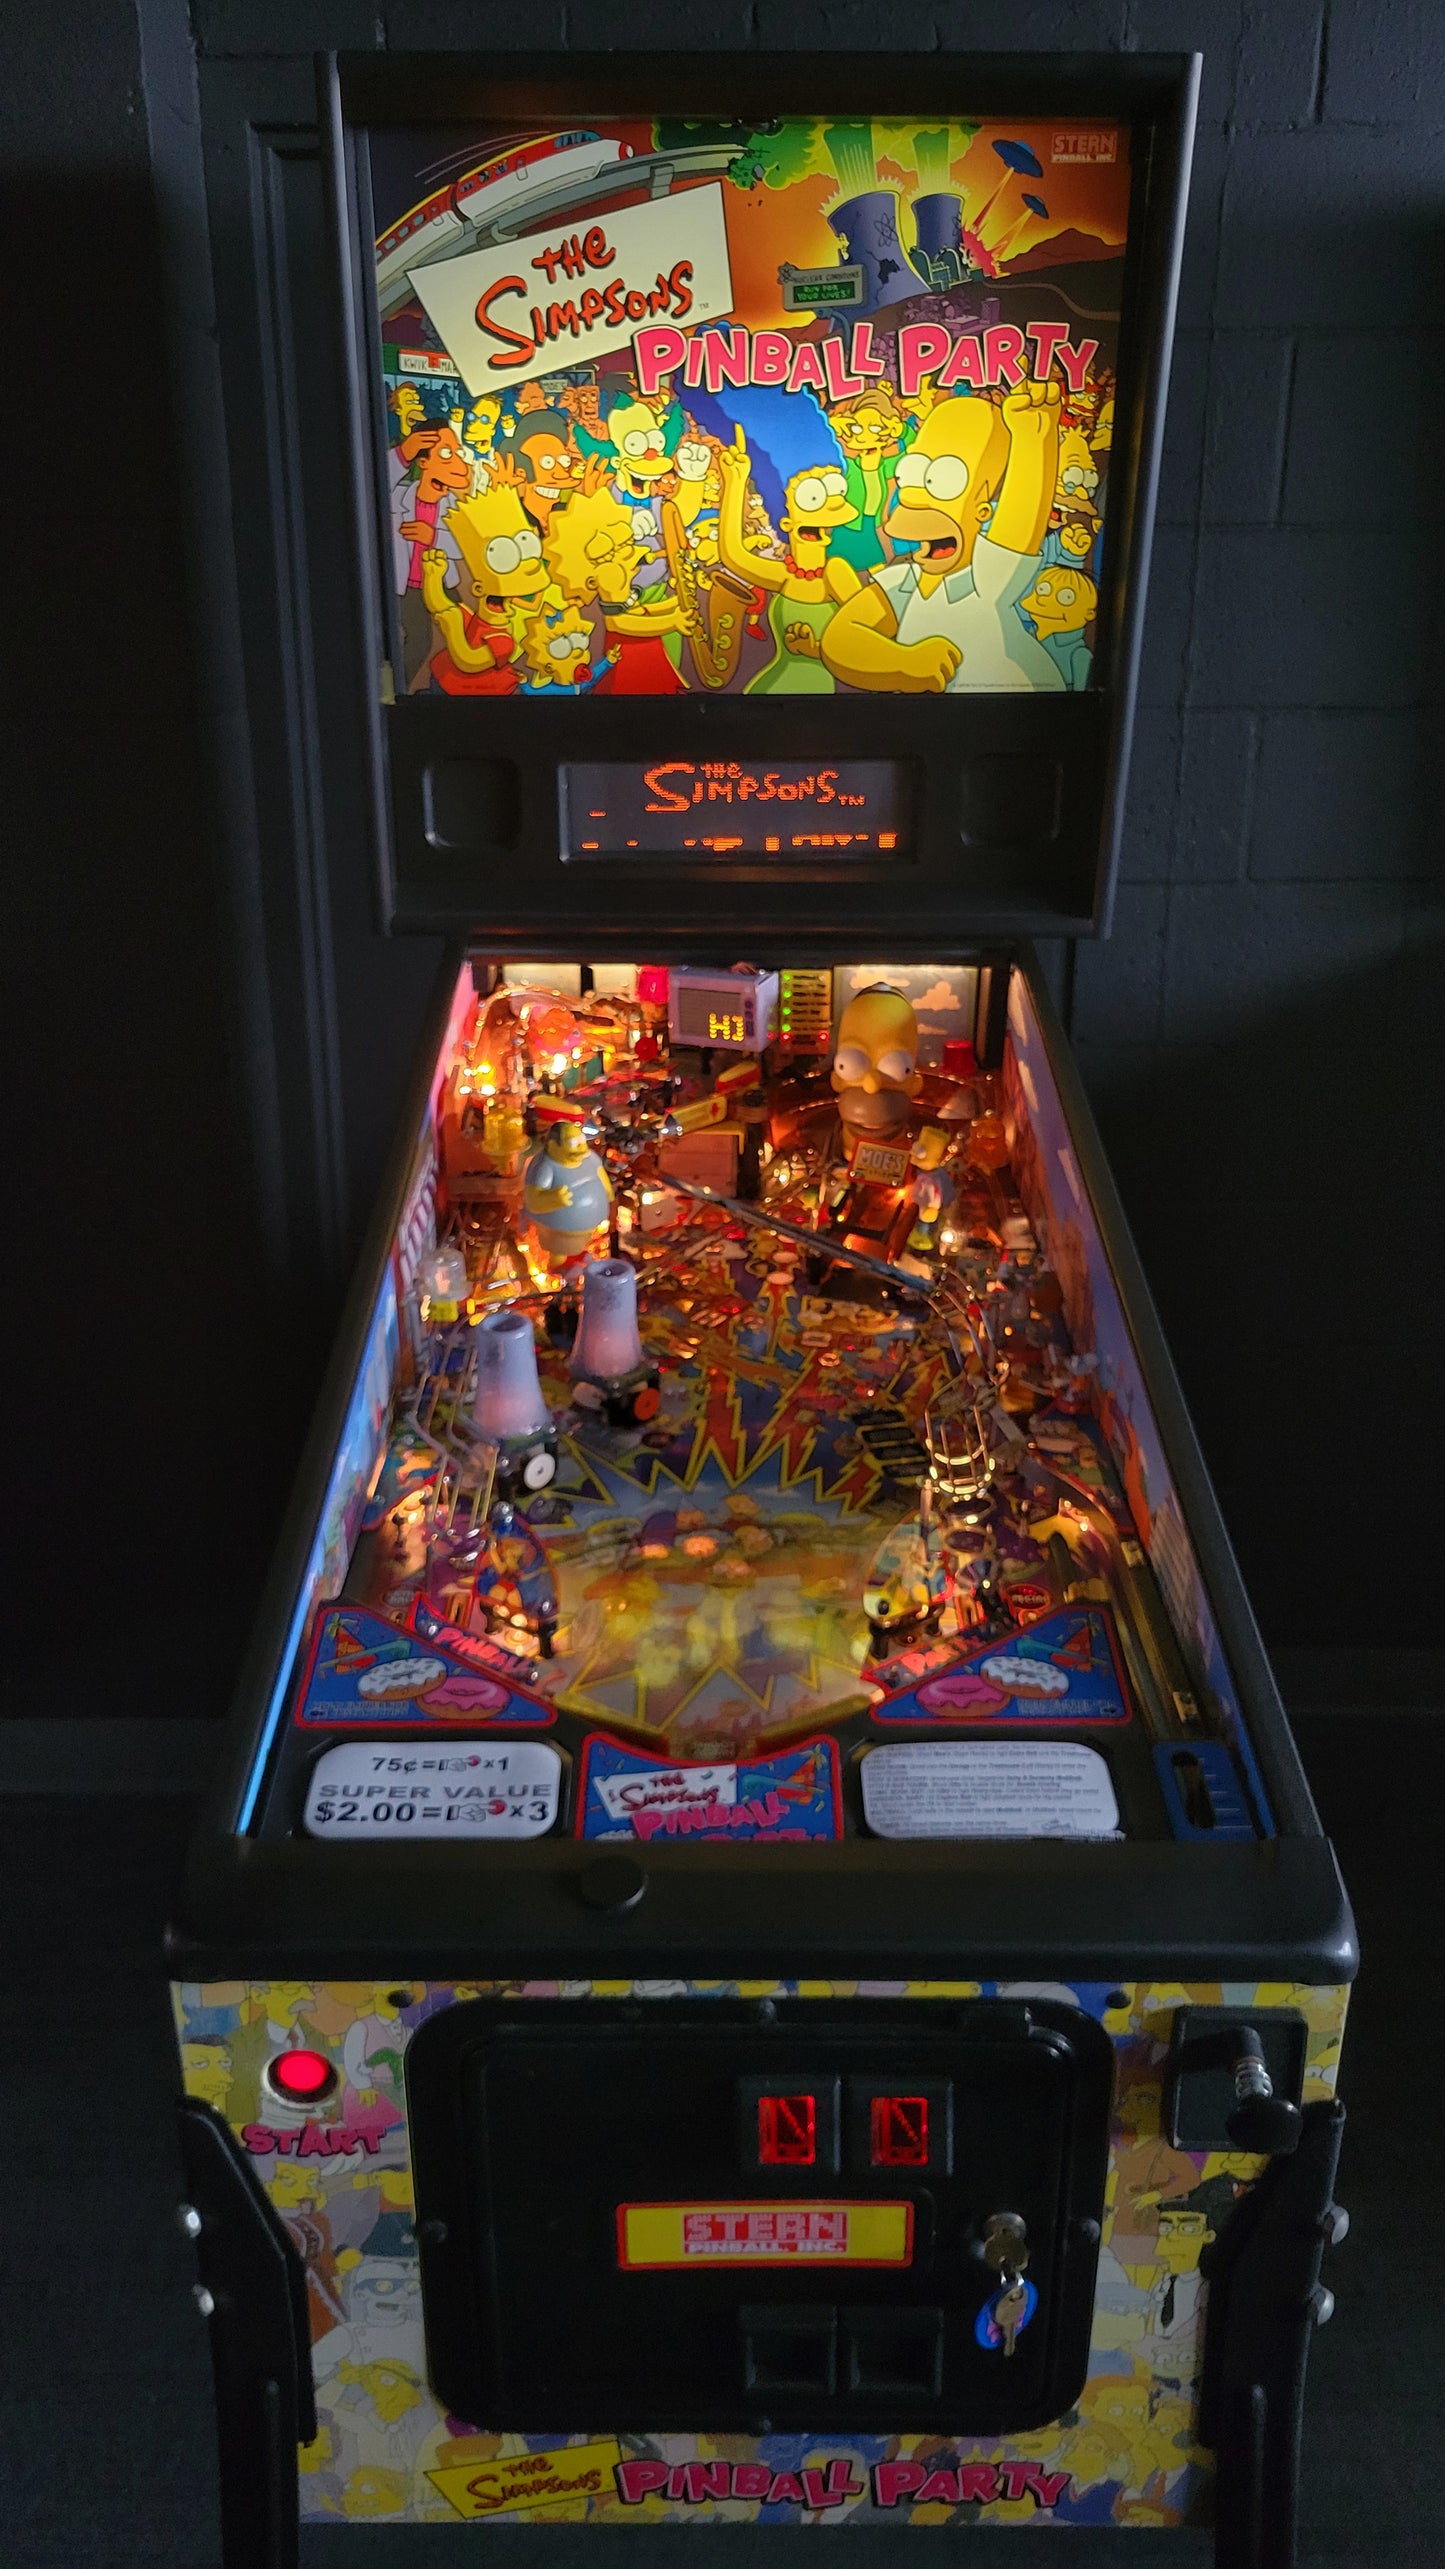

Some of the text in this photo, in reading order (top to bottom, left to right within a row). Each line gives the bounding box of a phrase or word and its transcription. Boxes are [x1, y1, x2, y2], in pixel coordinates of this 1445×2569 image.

[1054, 135, 1115, 153] STERN
[475, 260, 694, 370] SIMPSONS
[632, 321, 1100, 402] PINBALL PARTY
[644, 762, 840, 812] SIMPSONS
[319, 1784, 552, 1798] SUPER VALUE
[630, 1791, 790, 1841] PINBALL
[241, 2123, 387, 2157] START
[687, 2212, 844, 2240] STERN
[466, 2468, 602, 2510] SIMPSONS
[613, 2459, 1071, 2509] PINBALL PARTY
